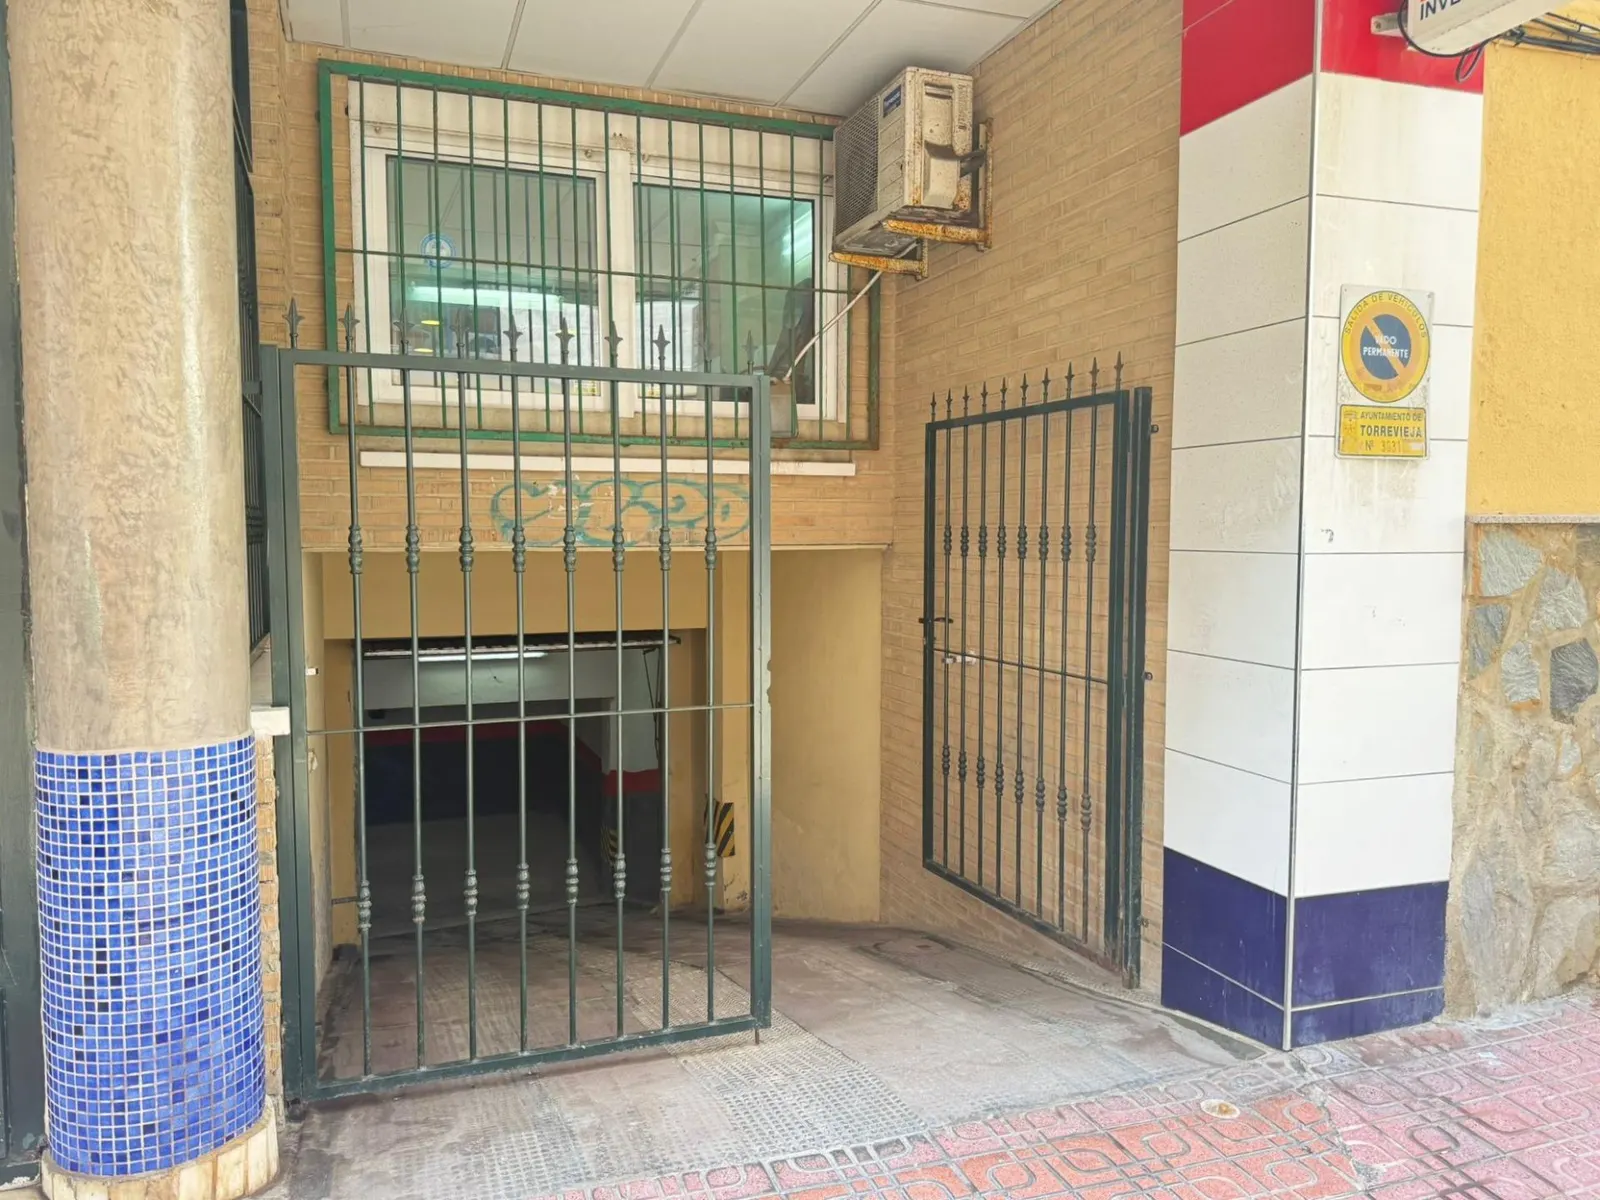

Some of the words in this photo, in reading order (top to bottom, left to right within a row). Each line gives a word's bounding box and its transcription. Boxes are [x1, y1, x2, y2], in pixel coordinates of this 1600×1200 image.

[1345, 300, 1370, 335] SALIDA
[1371, 293, 1384, 302] DE
[1362, 346, 1409, 359] PERMANENTE
[1360, 411, 1411, 421] AYUNTAMIENTO
[1412, 412, 1423, 422] DE
[1360, 425, 1423, 438] TORREVIEJA
